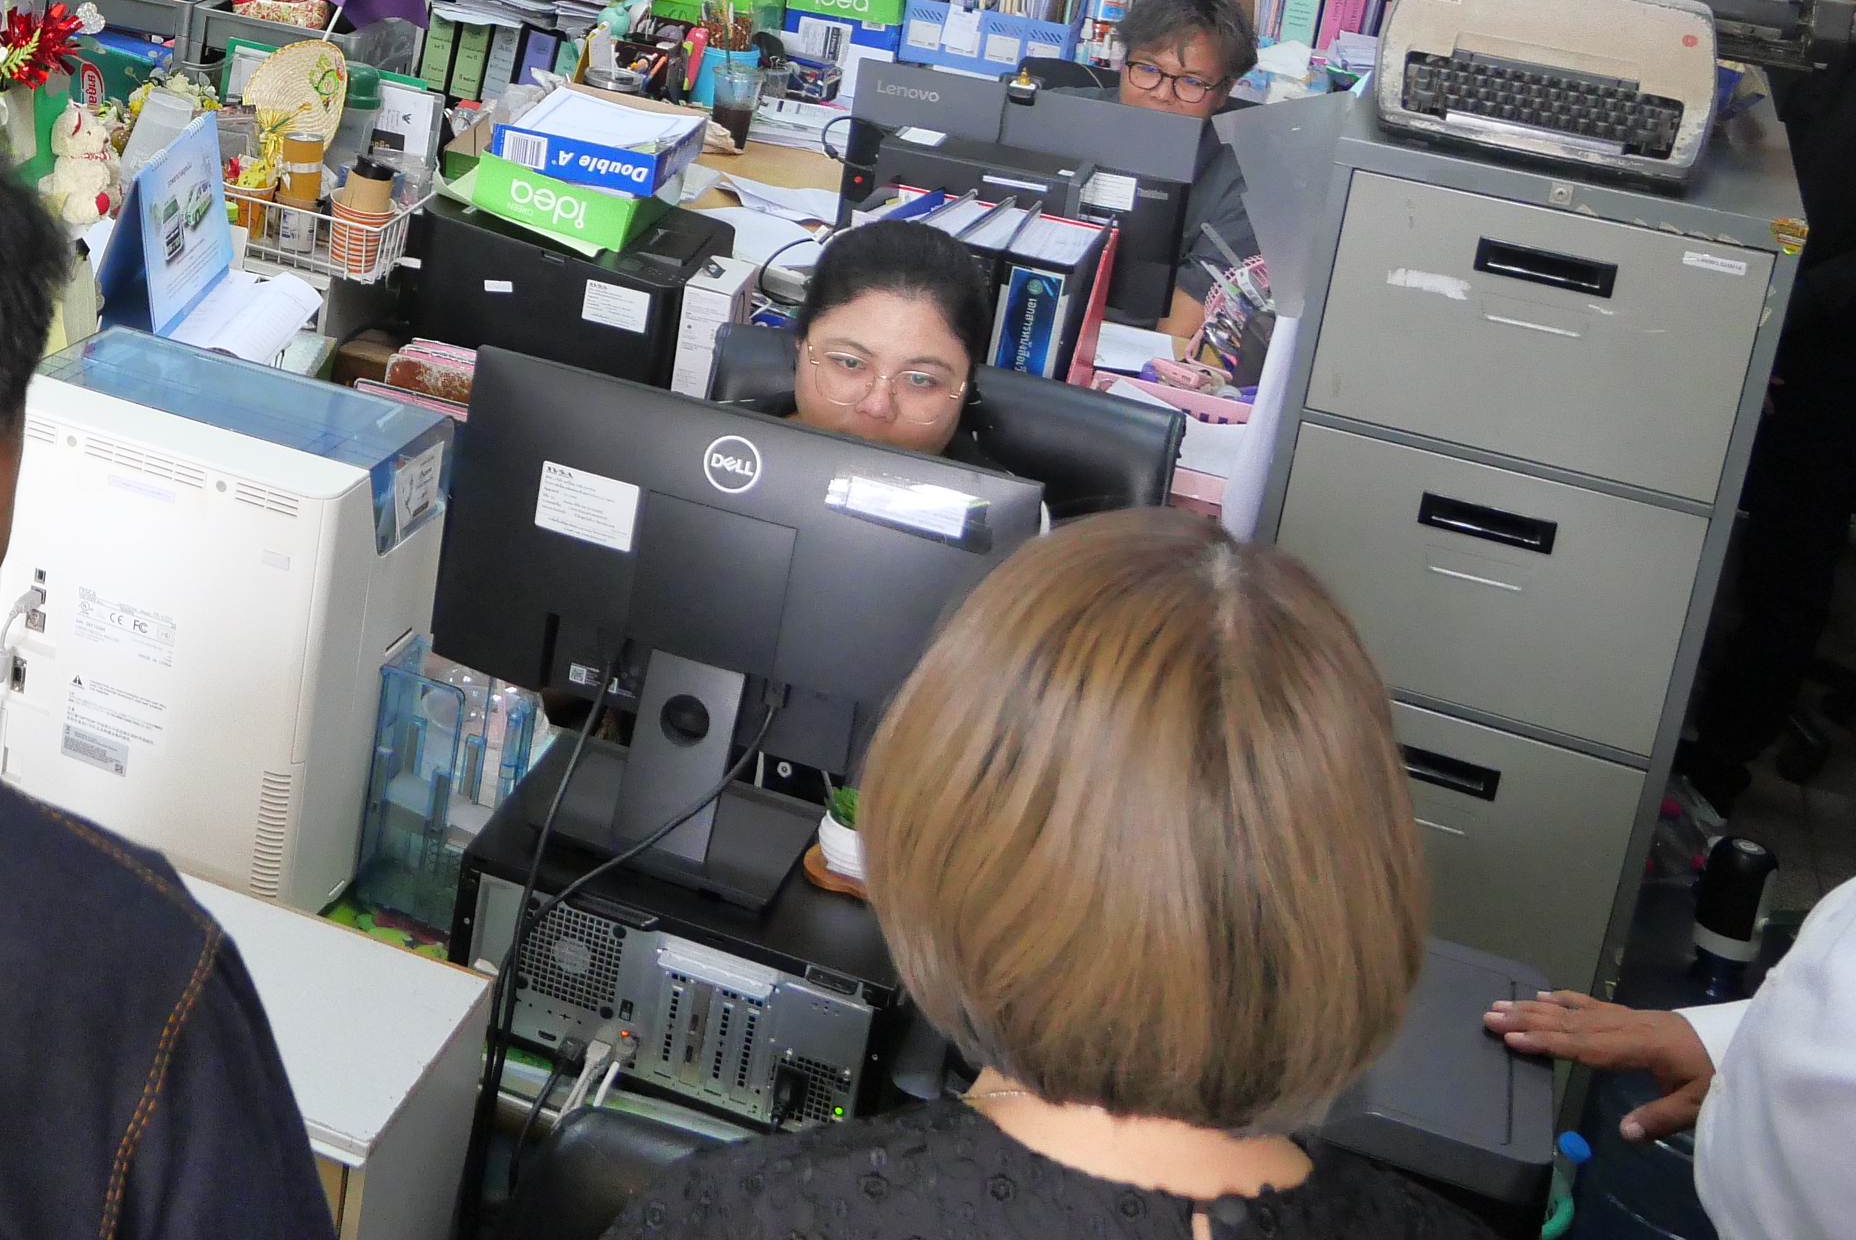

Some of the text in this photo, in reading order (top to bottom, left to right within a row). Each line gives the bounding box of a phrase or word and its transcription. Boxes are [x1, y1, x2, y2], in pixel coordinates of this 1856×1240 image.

[876, 80, 941, 103] Lenovo
[558, 150, 650, 183] Double A
[506, 201, 534, 217] GREEN
[510, 178, 587, 229] idea
[710, 452, 754, 477] DELL
